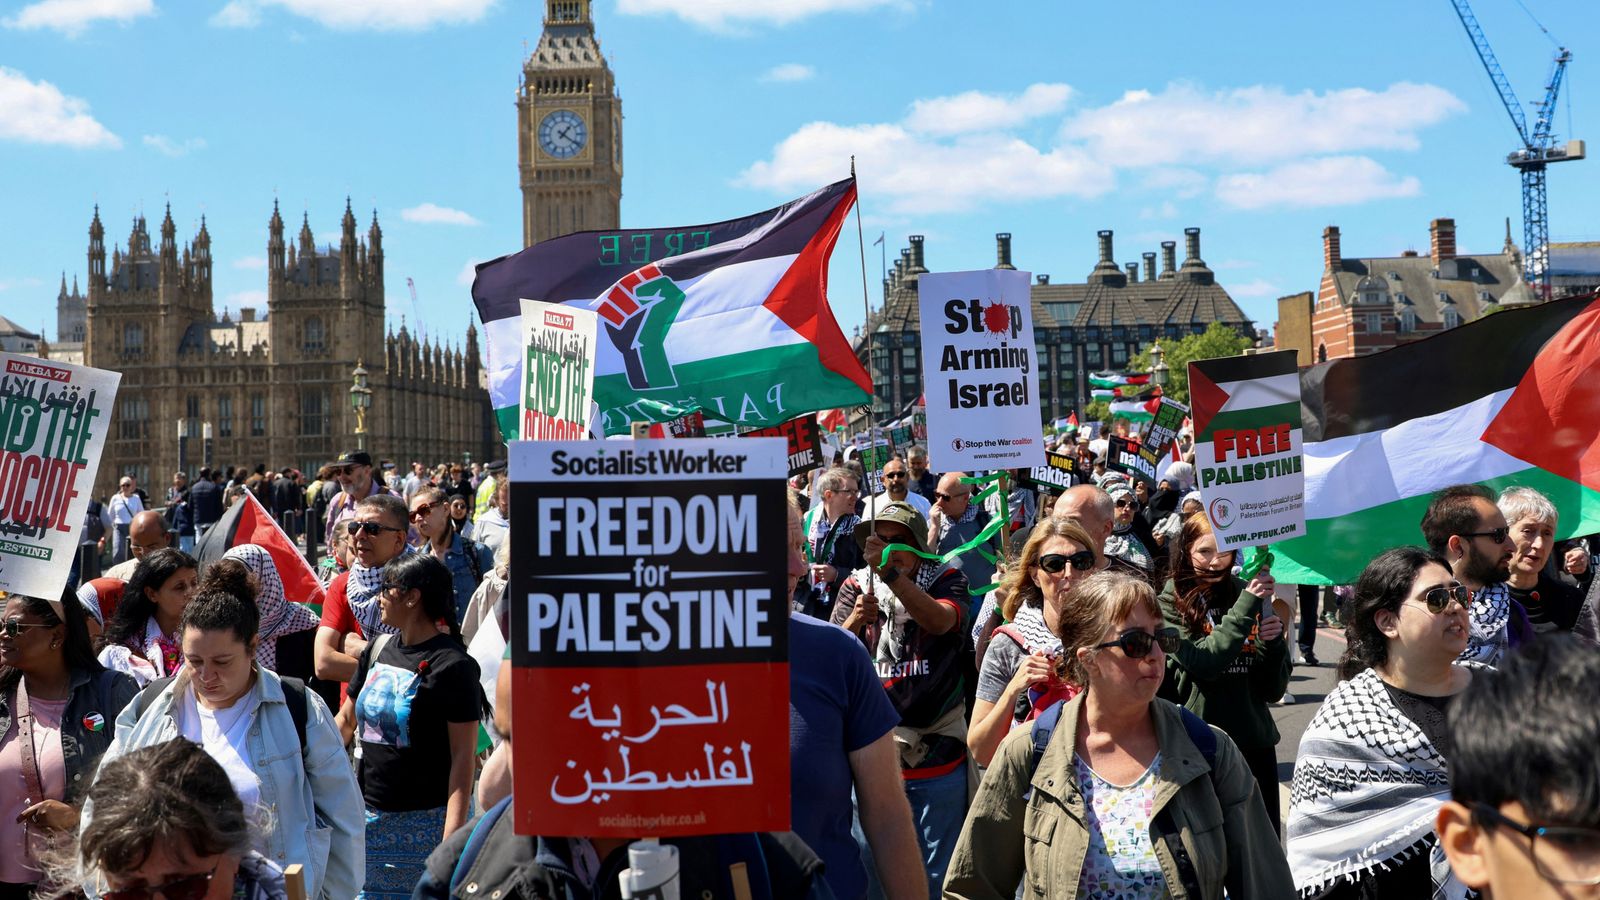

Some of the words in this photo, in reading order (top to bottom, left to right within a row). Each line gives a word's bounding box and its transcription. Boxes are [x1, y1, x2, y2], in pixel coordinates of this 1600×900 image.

[10, 362, 52, 378] NAKBA
[53, 371, 68, 380] 77
[940, 341, 1029, 374] Arming
[525, 345, 561, 417] END
[564, 357, 589, 427] THE
[949, 376, 1029, 409] Israel
[42, 408, 100, 465] THE
[965, 440, 984, 448] Stop
[997, 438, 1011, 446] War
[1213, 423, 1292, 463] FREE
[1030, 465, 1072, 488] nakba
[1050, 455, 1073, 471] MORE
[1120, 451, 1156, 480] nakba
[1201, 456, 1302, 488] PALESTINE
[538, 494, 758, 556] FREEDOM
[1224, 523, 1297, 545] WWW.PFBUK.COM
[633, 558, 669, 587] for
[528, 588, 772, 652] PALESTINE
[569, 678, 729, 743] الحرية
[551, 740, 754, 805] لفلسطين
[599, 810, 706, 829] socialistworker.co.uk
